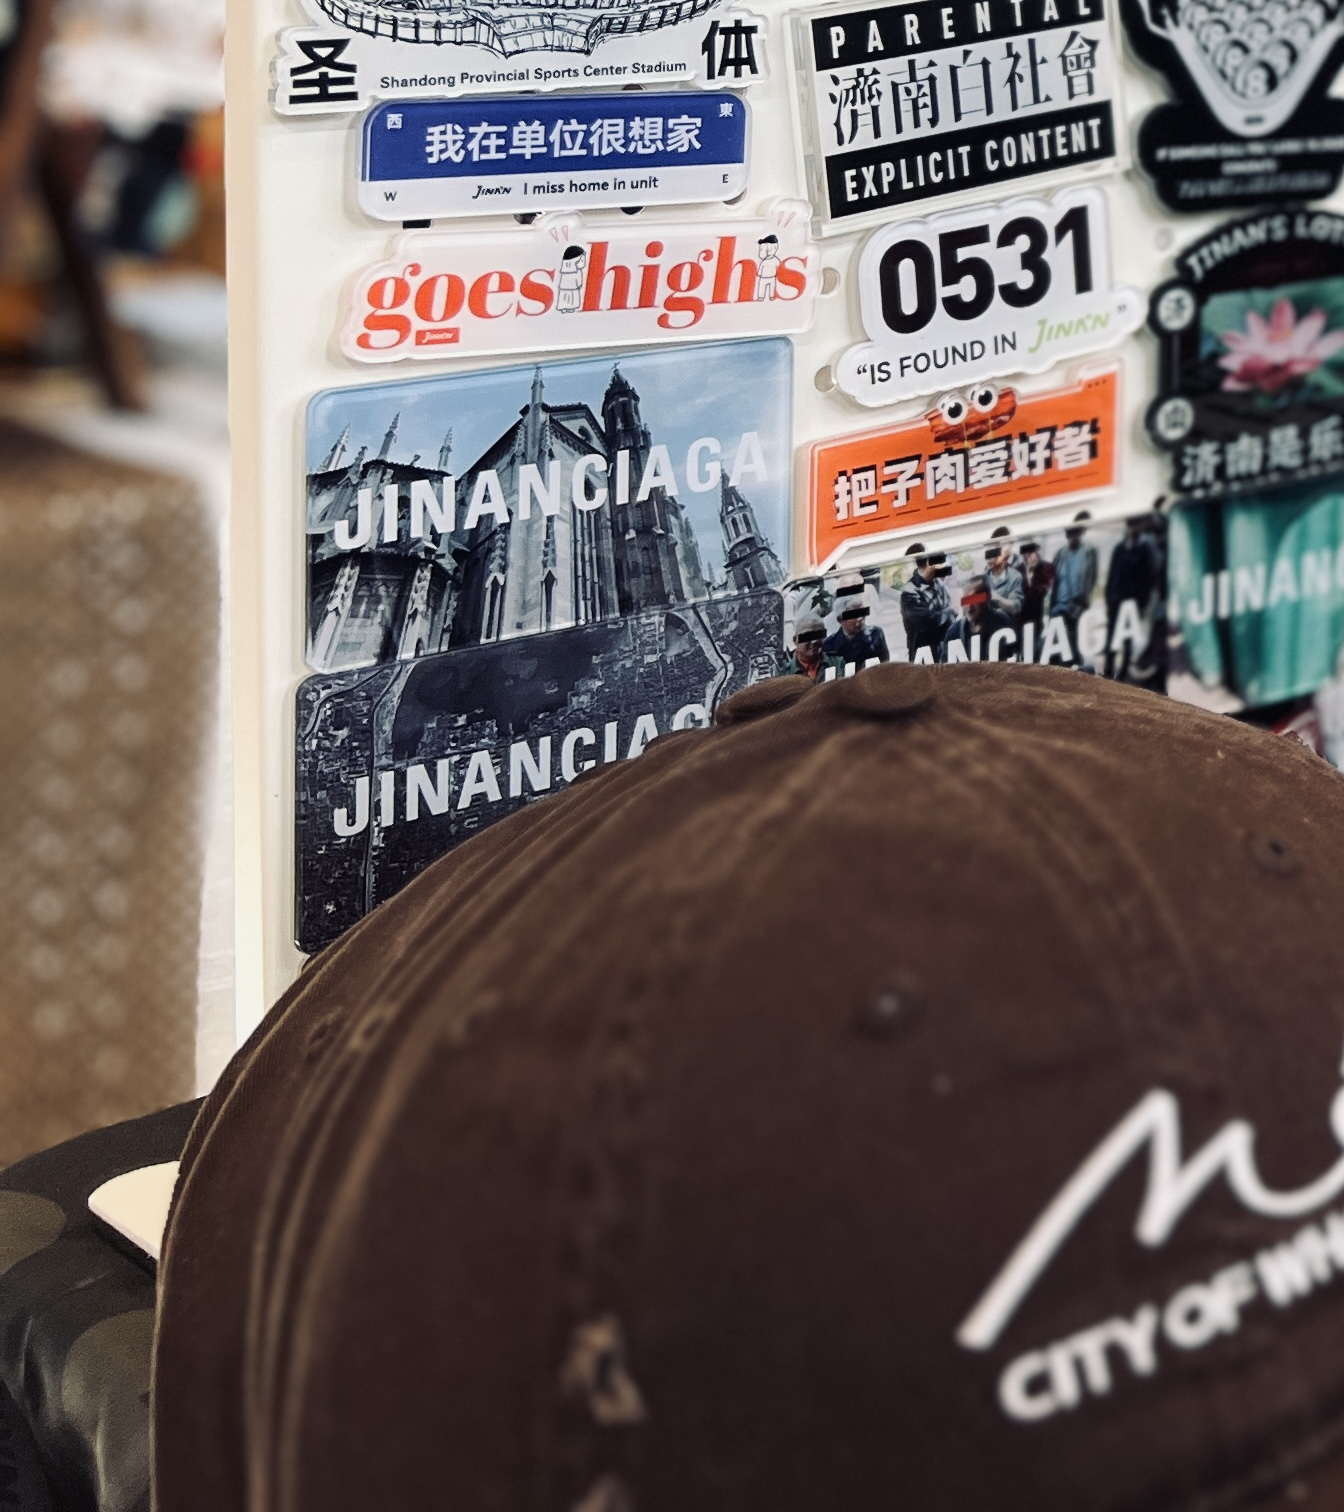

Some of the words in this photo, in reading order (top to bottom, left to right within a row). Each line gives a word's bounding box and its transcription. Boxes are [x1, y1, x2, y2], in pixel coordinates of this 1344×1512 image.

[289, 38, 360, 105] 圣
[701, 18, 760, 81] 体
[379, 73, 457, 90] Shandong
[460, 68, 531, 85] Provincial
[533, 65, 580, 83] Sports
[583, 62, 630, 78] Center
[631, 59, 688, 75] Stadium
[828, 29, 1101, 148] 濟南白社會
[387, 113, 404, 130] 西
[718, 101, 735, 119] 東
[424, 114, 703, 166] 我在单位很想家
[384, 190, 398, 203] W
[533, 180, 566, 196] miss
[569, 179, 610, 194] home
[613, 177, 627, 191] in
[630, 175, 660, 190] unit
[721, 173, 730, 185] E
[844, 144, 972, 203] EXPLICIT
[984, 117, 1101, 172] CONTENT
[355, 263, 557, 351] goes
[878, 204, 1094, 335] 0531
[899, 339, 986, 378] FOUND
[993, 331, 1018, 356] IN
[333, 430, 771, 552] JINANCIAGA
[834, 417, 1102, 522] 把子肉爱好者
[333, 703, 711, 838] JINANCIAG
[999, 1302, 1160, 1421] CITY
[1161, 1261, 1257, 1350] OF
